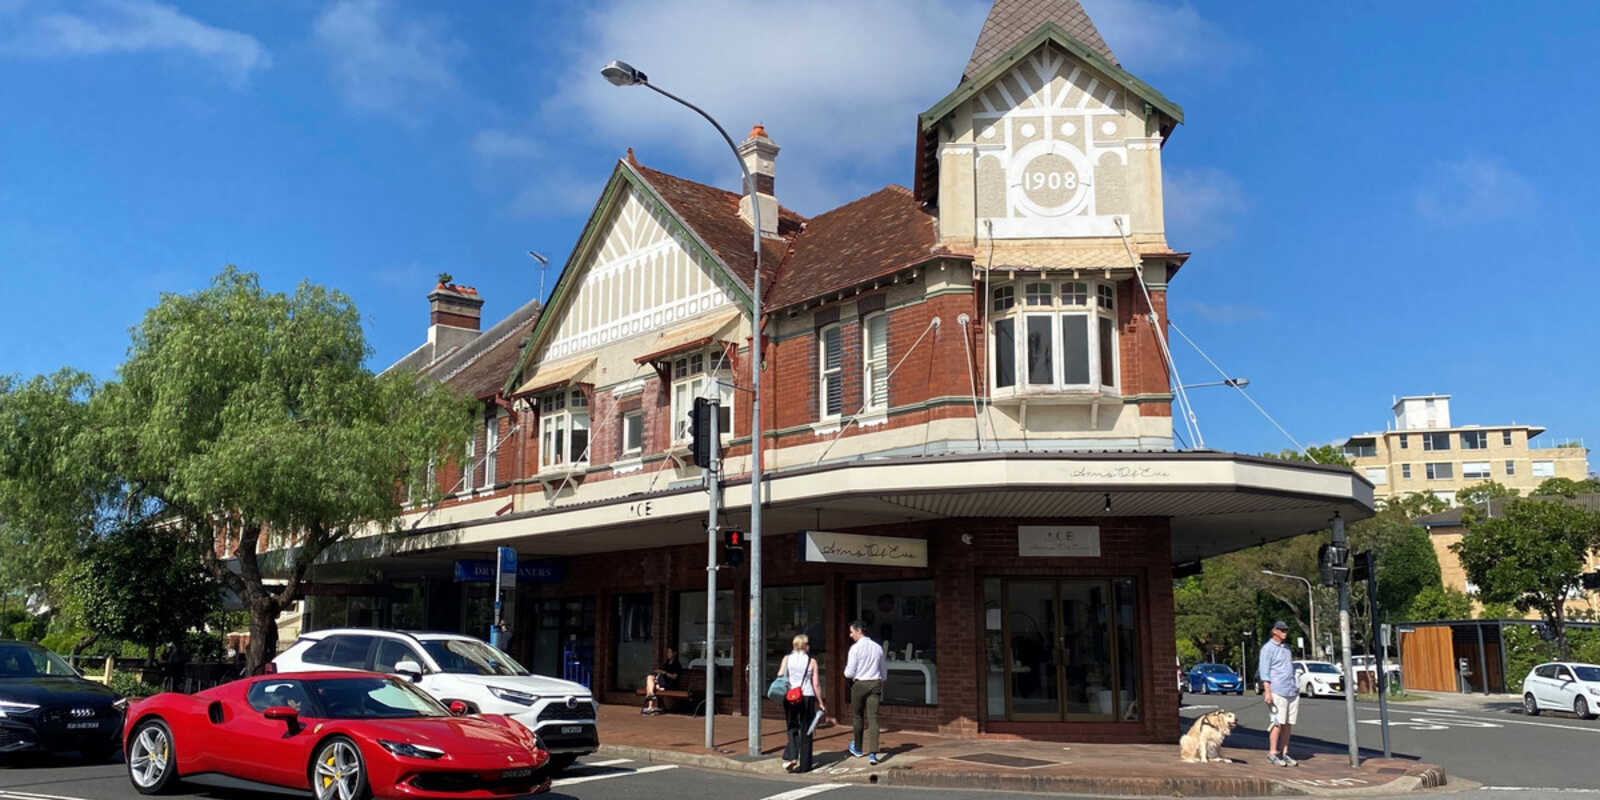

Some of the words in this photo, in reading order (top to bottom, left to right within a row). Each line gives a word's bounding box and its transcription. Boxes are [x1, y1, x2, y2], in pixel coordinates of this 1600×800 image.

[1025, 172, 1076, 190] 1908
[474, 566, 496, 577] DRY
[517, 567, 553, 577] ANERS
